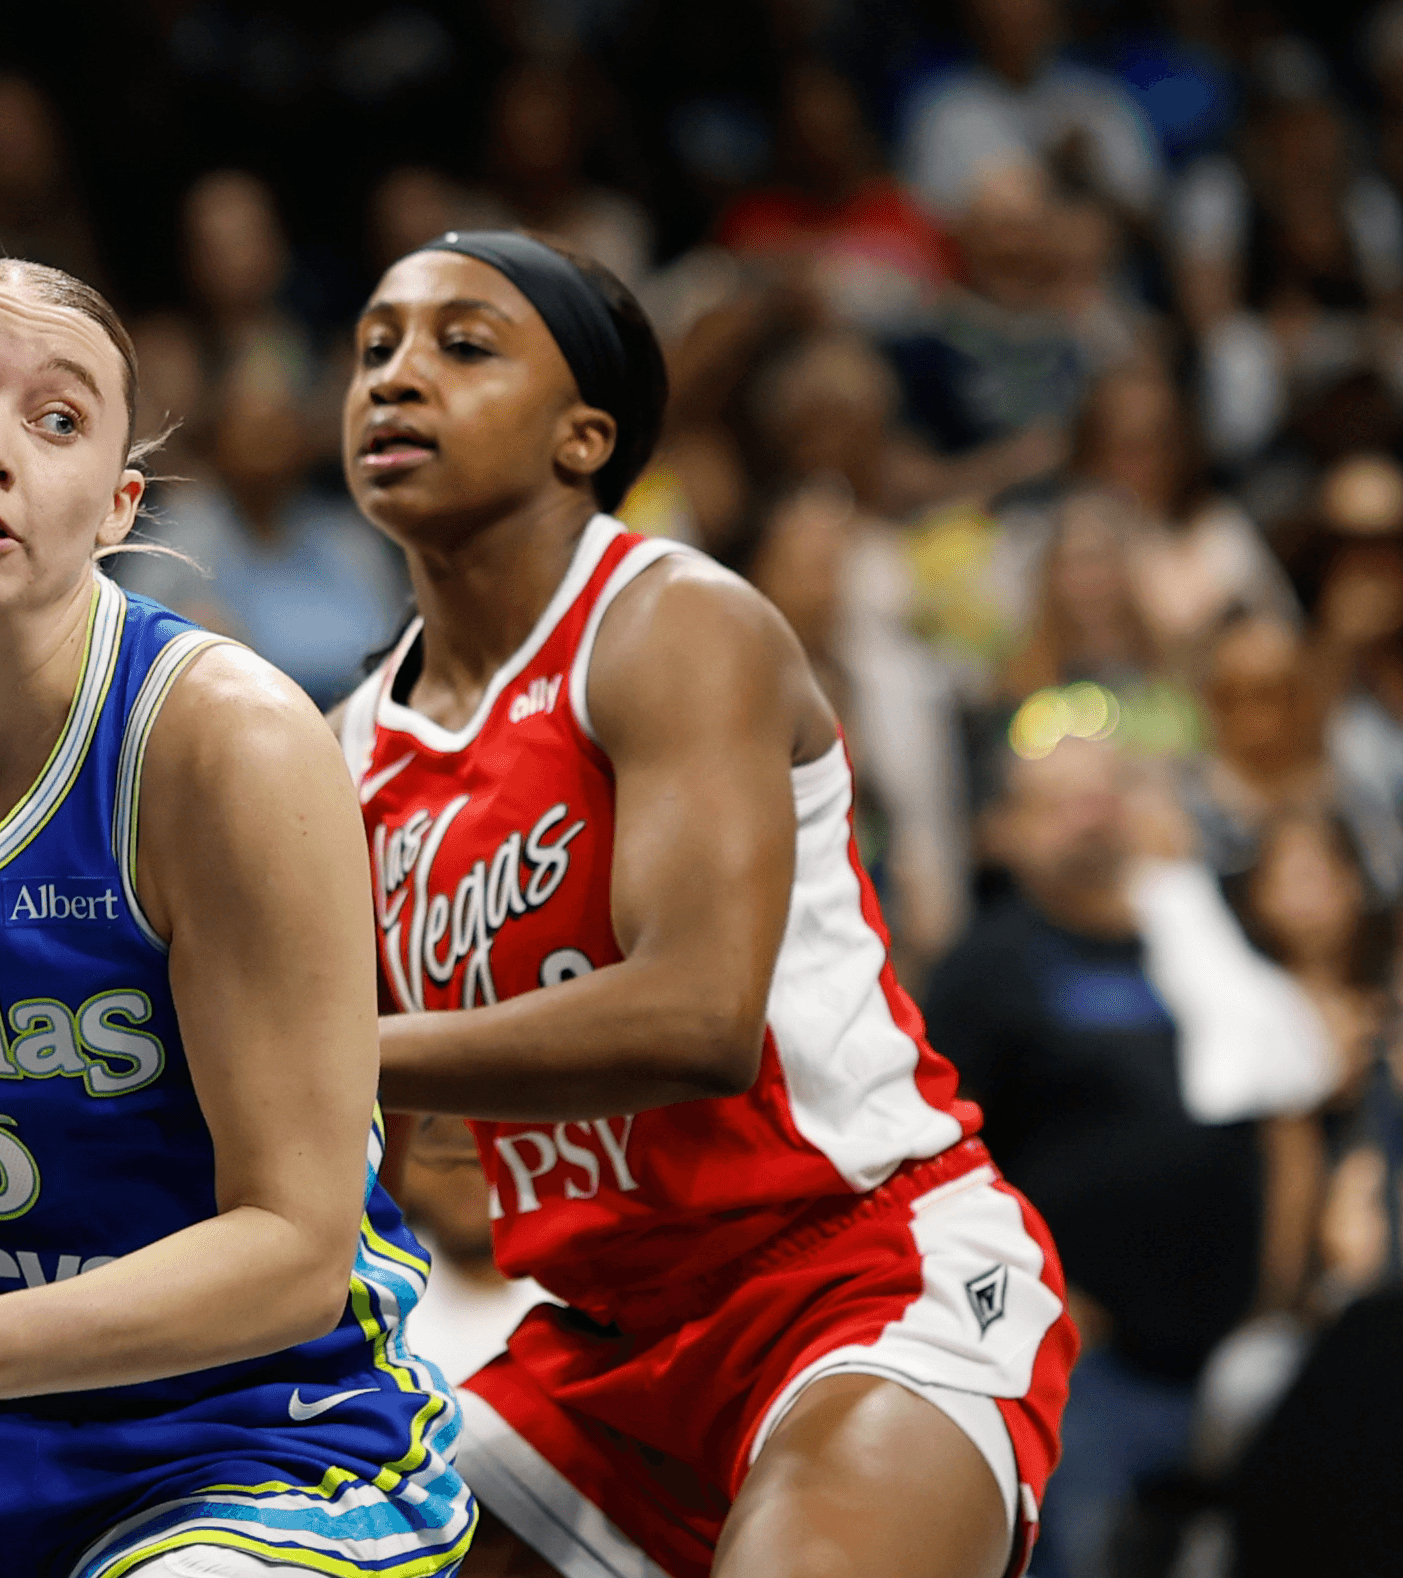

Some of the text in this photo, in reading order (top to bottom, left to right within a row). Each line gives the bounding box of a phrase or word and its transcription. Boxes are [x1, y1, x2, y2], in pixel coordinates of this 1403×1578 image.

[509, 673, 563, 723] ally
[10, 884, 119, 920] Albert
[385, 793, 587, 1012] Vegas
[489, 1113, 639, 1221] PSY
